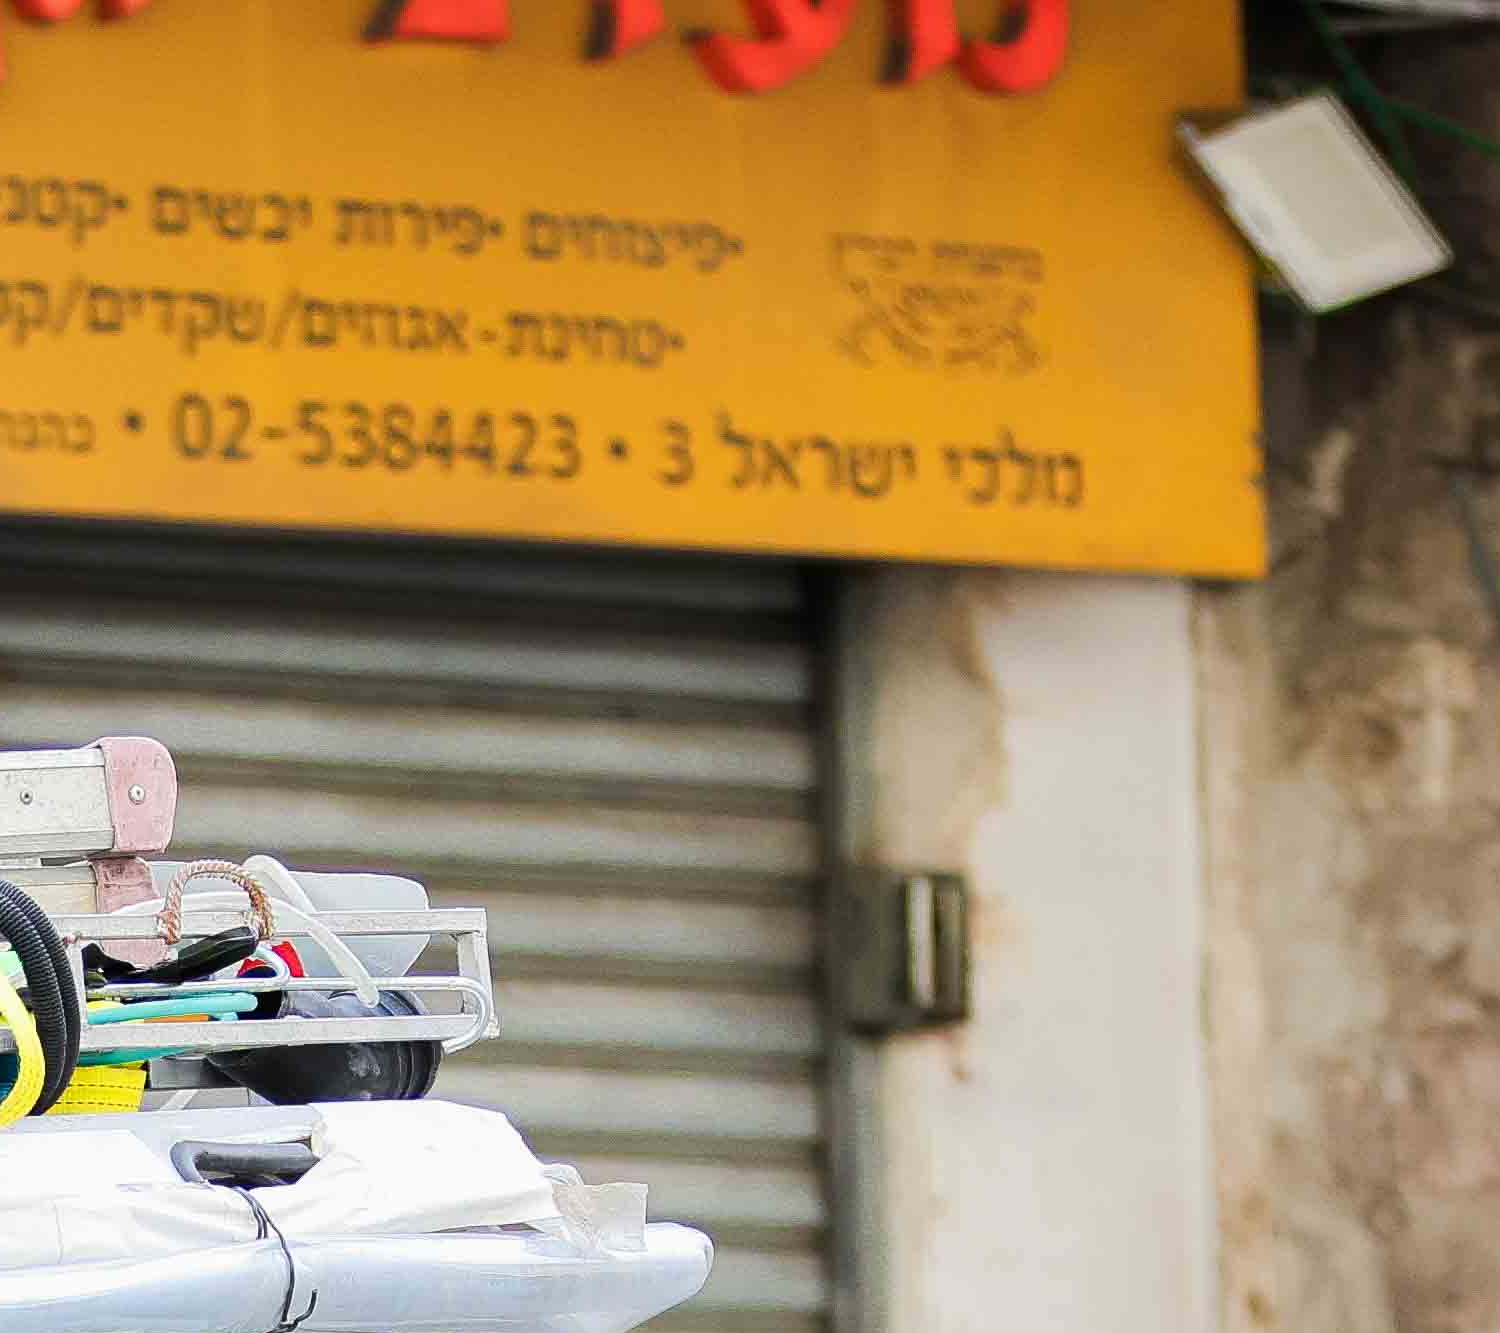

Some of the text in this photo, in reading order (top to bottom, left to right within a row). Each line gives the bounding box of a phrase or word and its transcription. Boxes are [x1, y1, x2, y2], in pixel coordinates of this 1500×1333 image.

[150, 184, 314, 243] יבשים
[334, 197, 489, 256] פירות
[169, 391, 586, 482] 02-5384423
[658, 416, 696, 490] 3
[713, 409, 918, 501] ישראל
[940, 426, 1084, 510] מלכי
